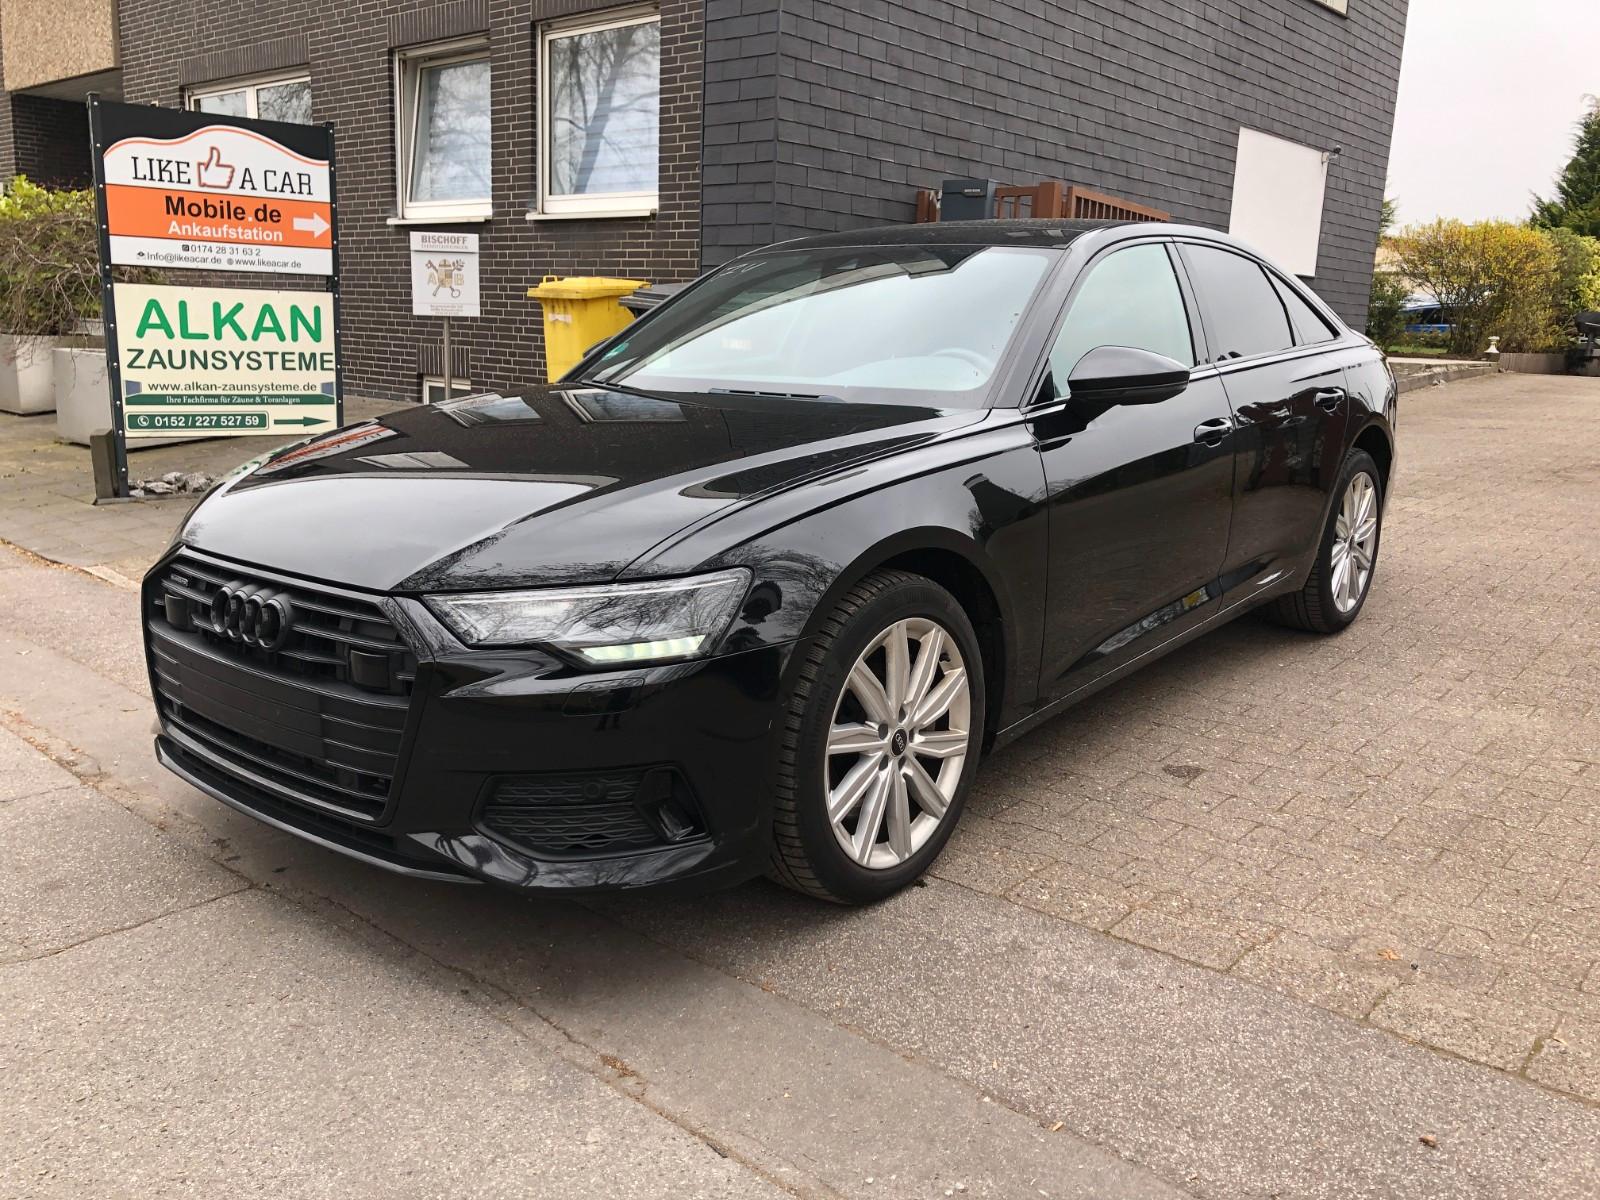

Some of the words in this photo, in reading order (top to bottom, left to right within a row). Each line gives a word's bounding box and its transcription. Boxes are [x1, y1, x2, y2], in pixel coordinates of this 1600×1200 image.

[131, 156, 191, 185] LIKE
[239, 168, 257, 191] A
[264, 169, 313, 195] CAR
[165, 196, 282, 223] Mobile.de
[168, 220, 283, 241] Ankaufstation
[421, 235, 468, 244] BISCHOFF
[191, 244, 213, 253] 0174
[215, 246, 227, 255] 28
[229, 247, 239, 255] 31
[242, 248, 253, 256] 63
[255, 248, 261, 256] 2
[235, 257, 302, 269] www.likeacar.de
[136, 298, 322, 343] ALKAN
[126, 348, 335, 372] ZAUNSYSTEME
[148, 381, 317, 394] www.alkan-zaunsysteme.de
[166, 395, 181, 404] Ihre
[255, 396, 261, 404] &
[154, 416, 185, 427] 0152
[195, 415, 217, 427] 227
[220, 415, 242, 426] 527
[245, 415, 259, 426] 59
